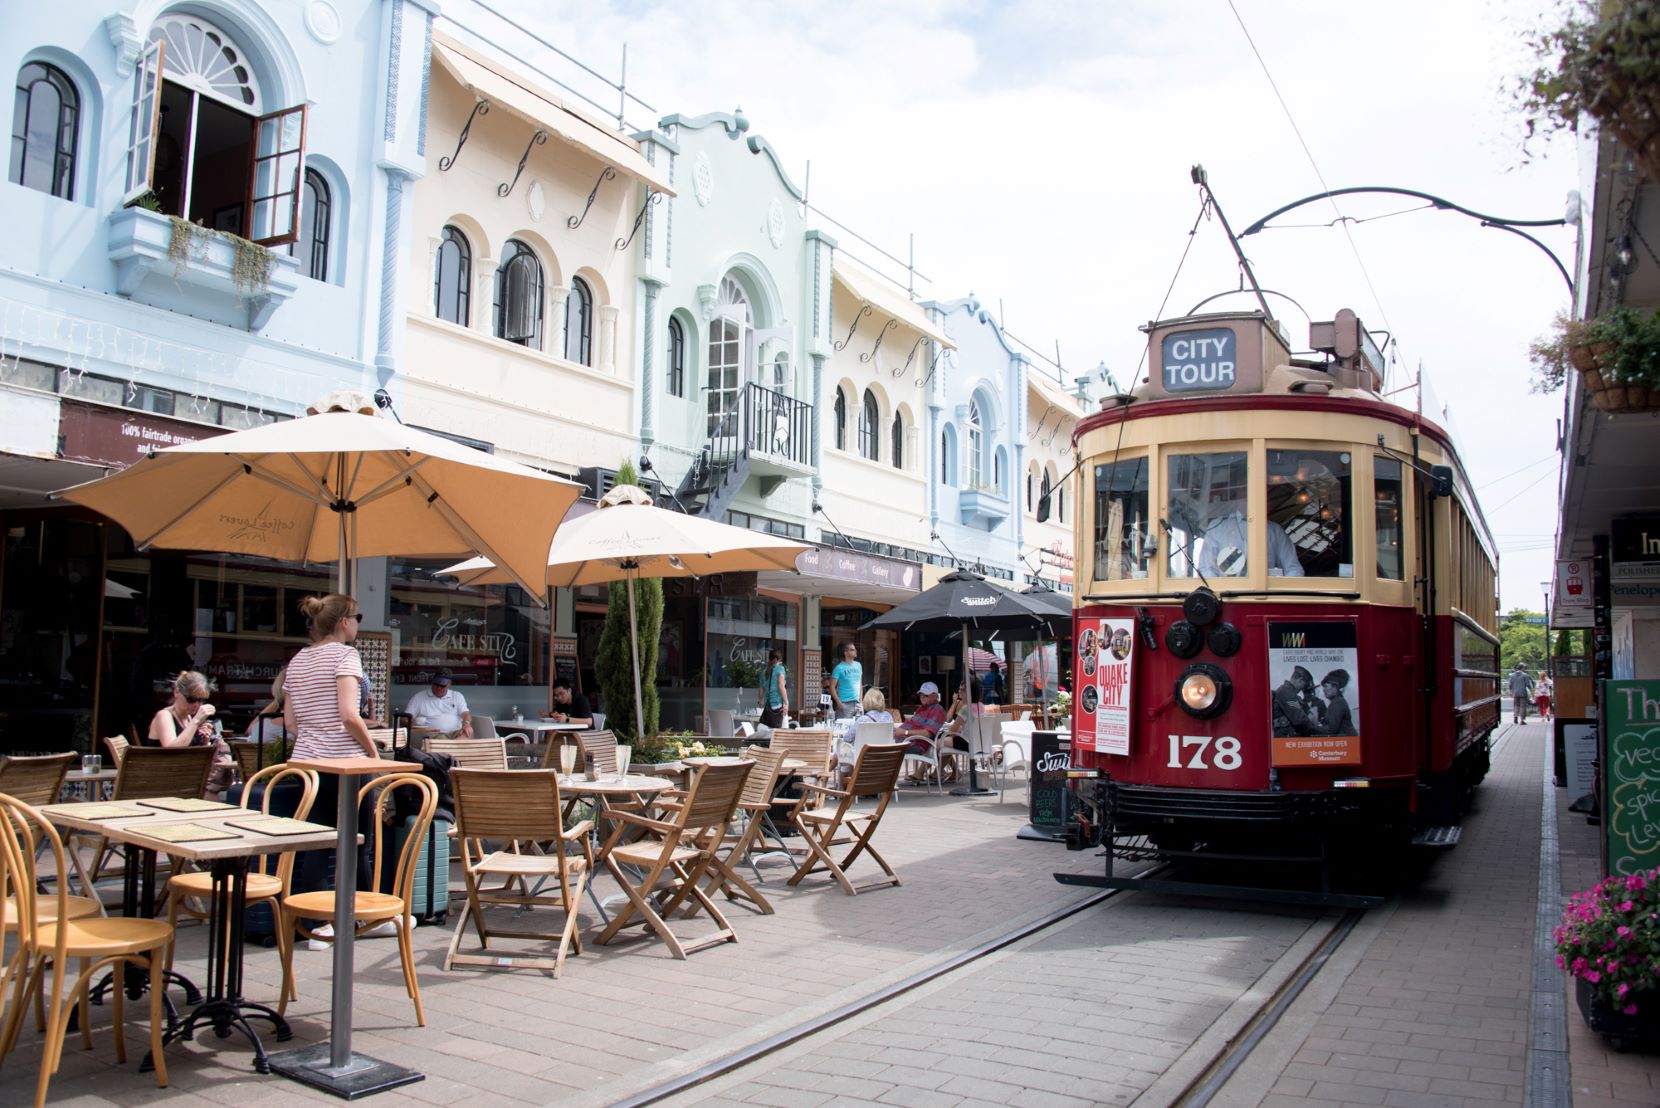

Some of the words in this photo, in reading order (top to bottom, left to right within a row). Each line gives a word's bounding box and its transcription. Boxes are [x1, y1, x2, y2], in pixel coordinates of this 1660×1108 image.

[1172, 336, 1228, 361] CITY
[1165, 361, 1235, 384] TOUR
[121, 423, 140, 437] 100%
[141, 427, 172, 442] fairtrade
[136, 443, 151, 454] and
[805, 553, 819, 565] Food
[838, 559, 856, 571] Coffee
[872, 565, 889, 579] Gallery
[1618, 567, 1660, 577] POLISHE
[1100, 664, 1127, 687] QUAKE
[1103, 684, 1122, 705] CITY
[1167, 735, 1242, 770] 178
